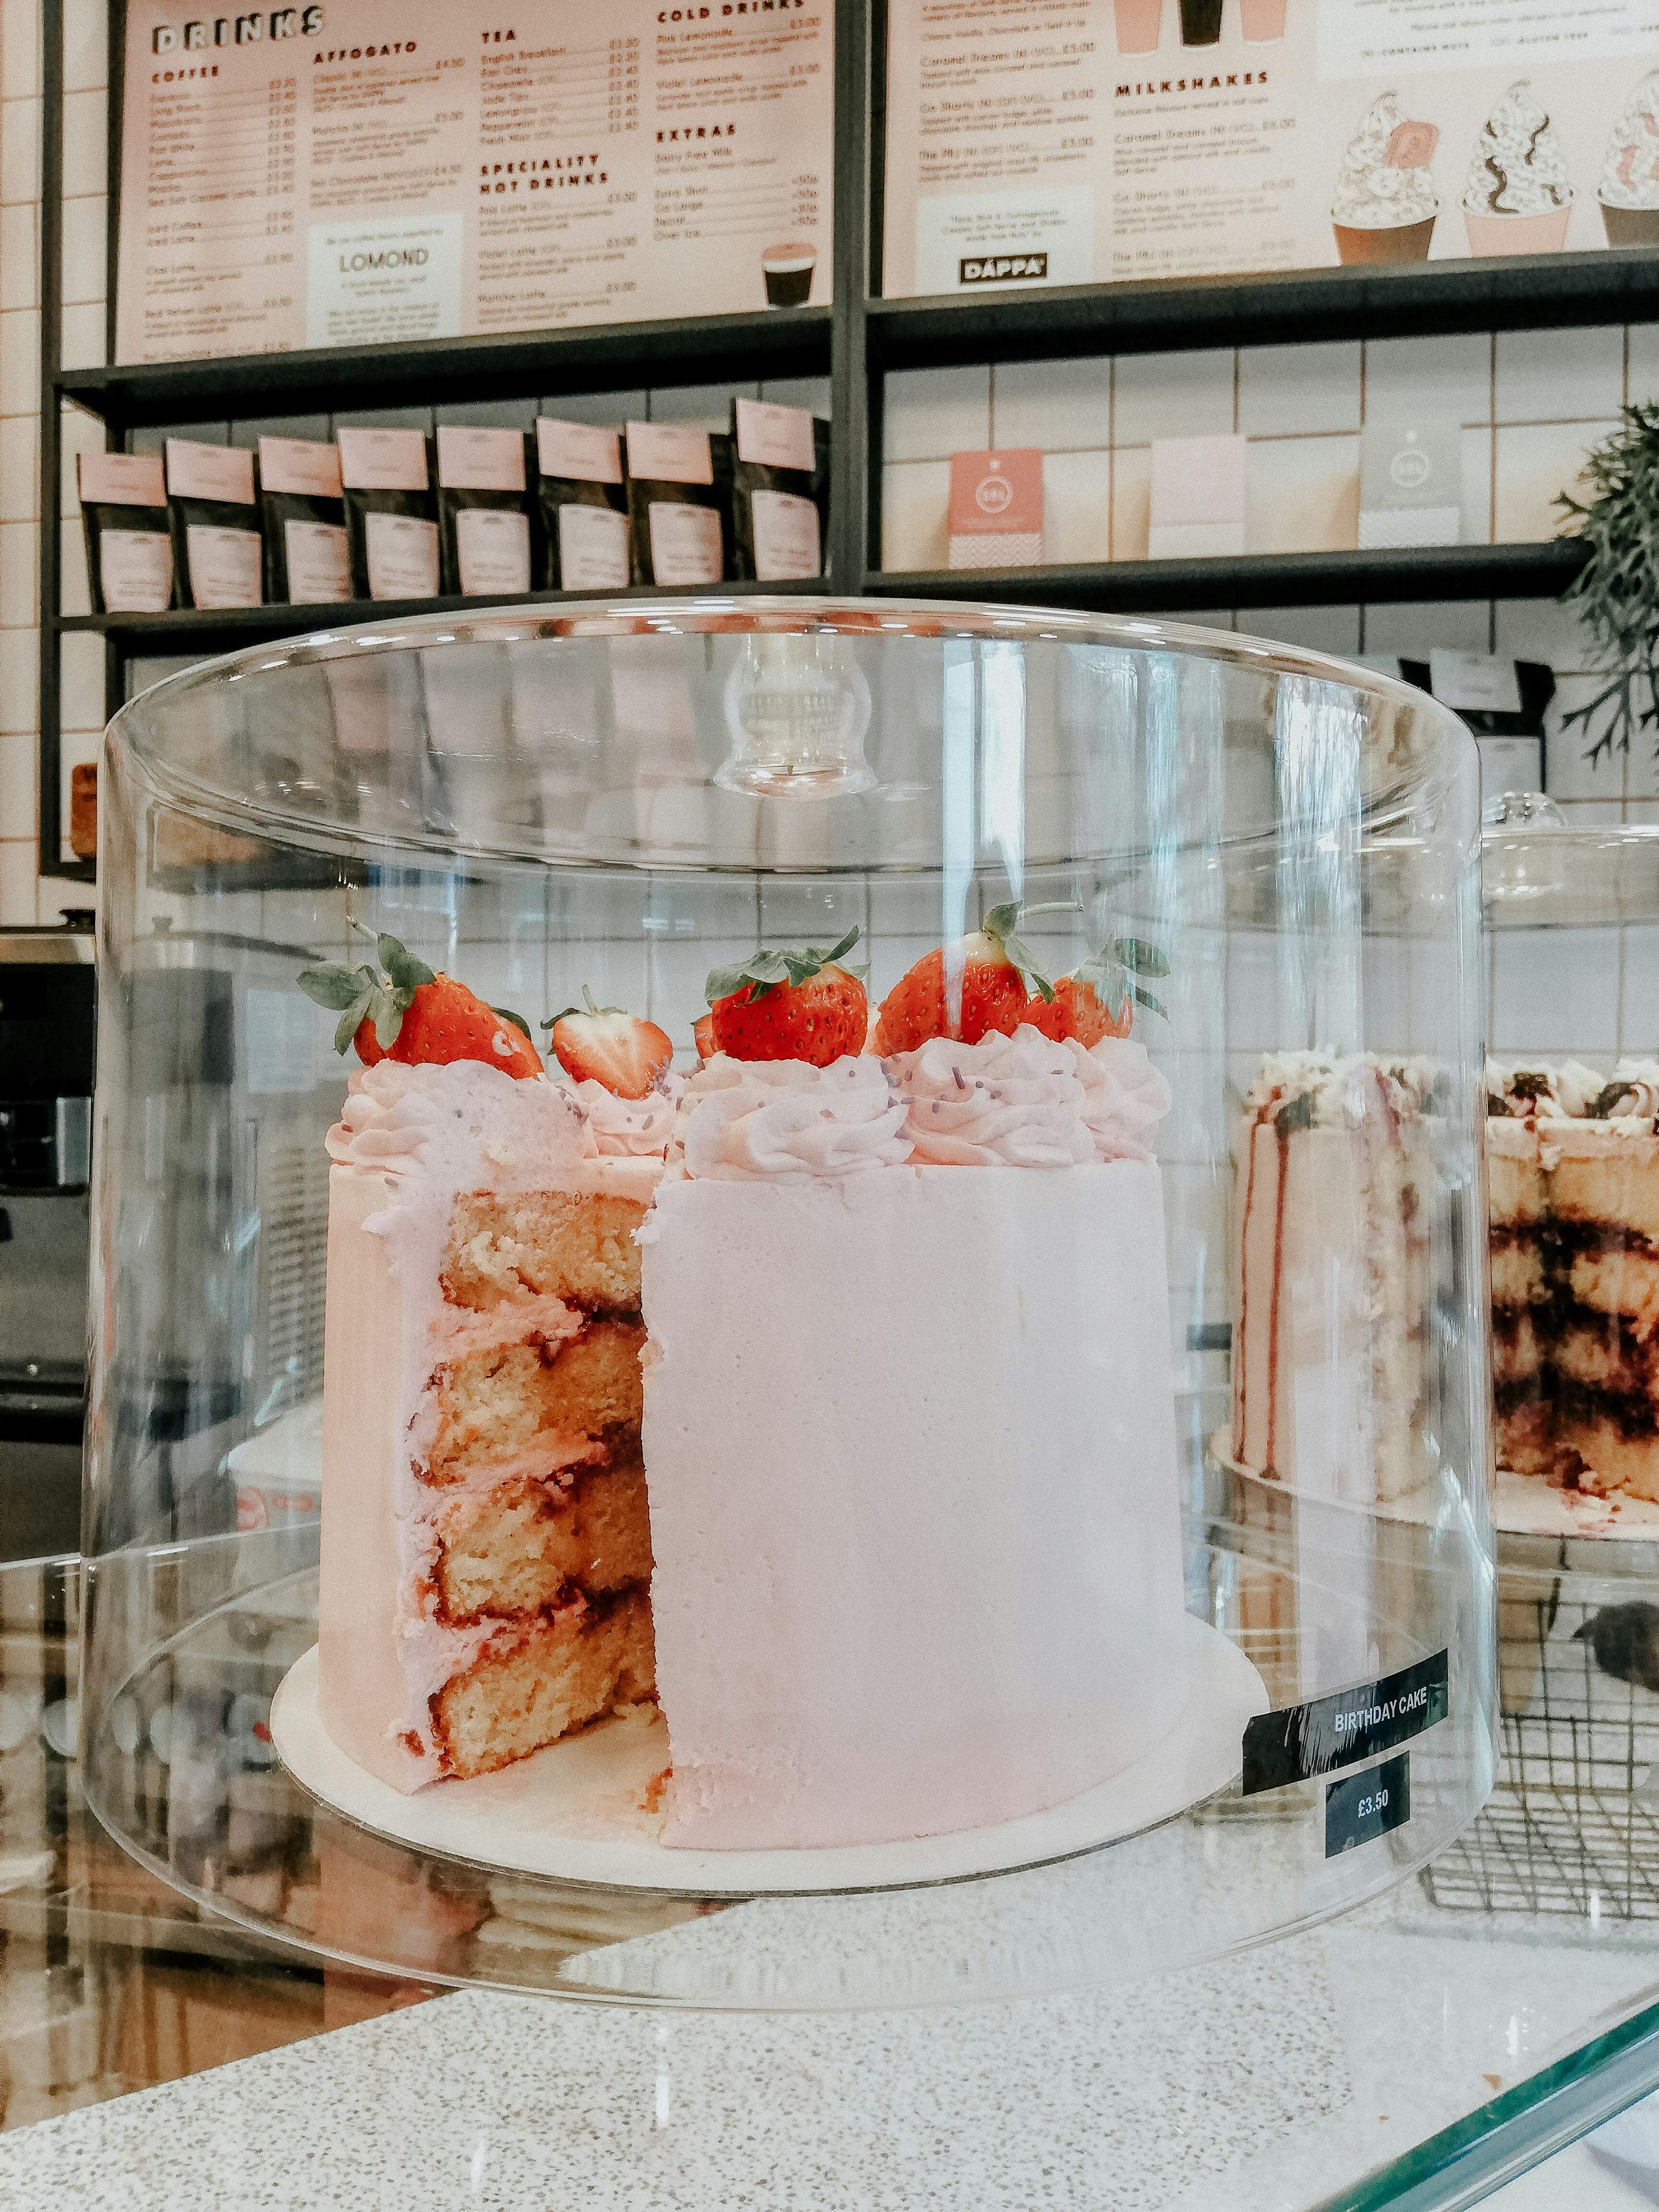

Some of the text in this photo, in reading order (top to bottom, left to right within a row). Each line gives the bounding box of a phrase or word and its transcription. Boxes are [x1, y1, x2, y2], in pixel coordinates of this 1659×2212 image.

[657, 0, 805, 24] COLD DRINKS
[151, 5, 323, 55] DRINKS
[481, 29, 517, 44] TEA
[313, 41, 417, 64] AFFOGATO
[1115, 71, 1269, 97] MILKSHAKES
[656, 123, 736, 144] EXTRAS
[480, 154, 600, 177] SPECIALITY
[479, 172, 609, 195] HOT DRINKS
[339, 248, 430, 273] LOMOND
[1335, 1686, 1427, 1732] BIRTHDAY CAKE
[1358, 1789, 1389, 1818] £3.50
